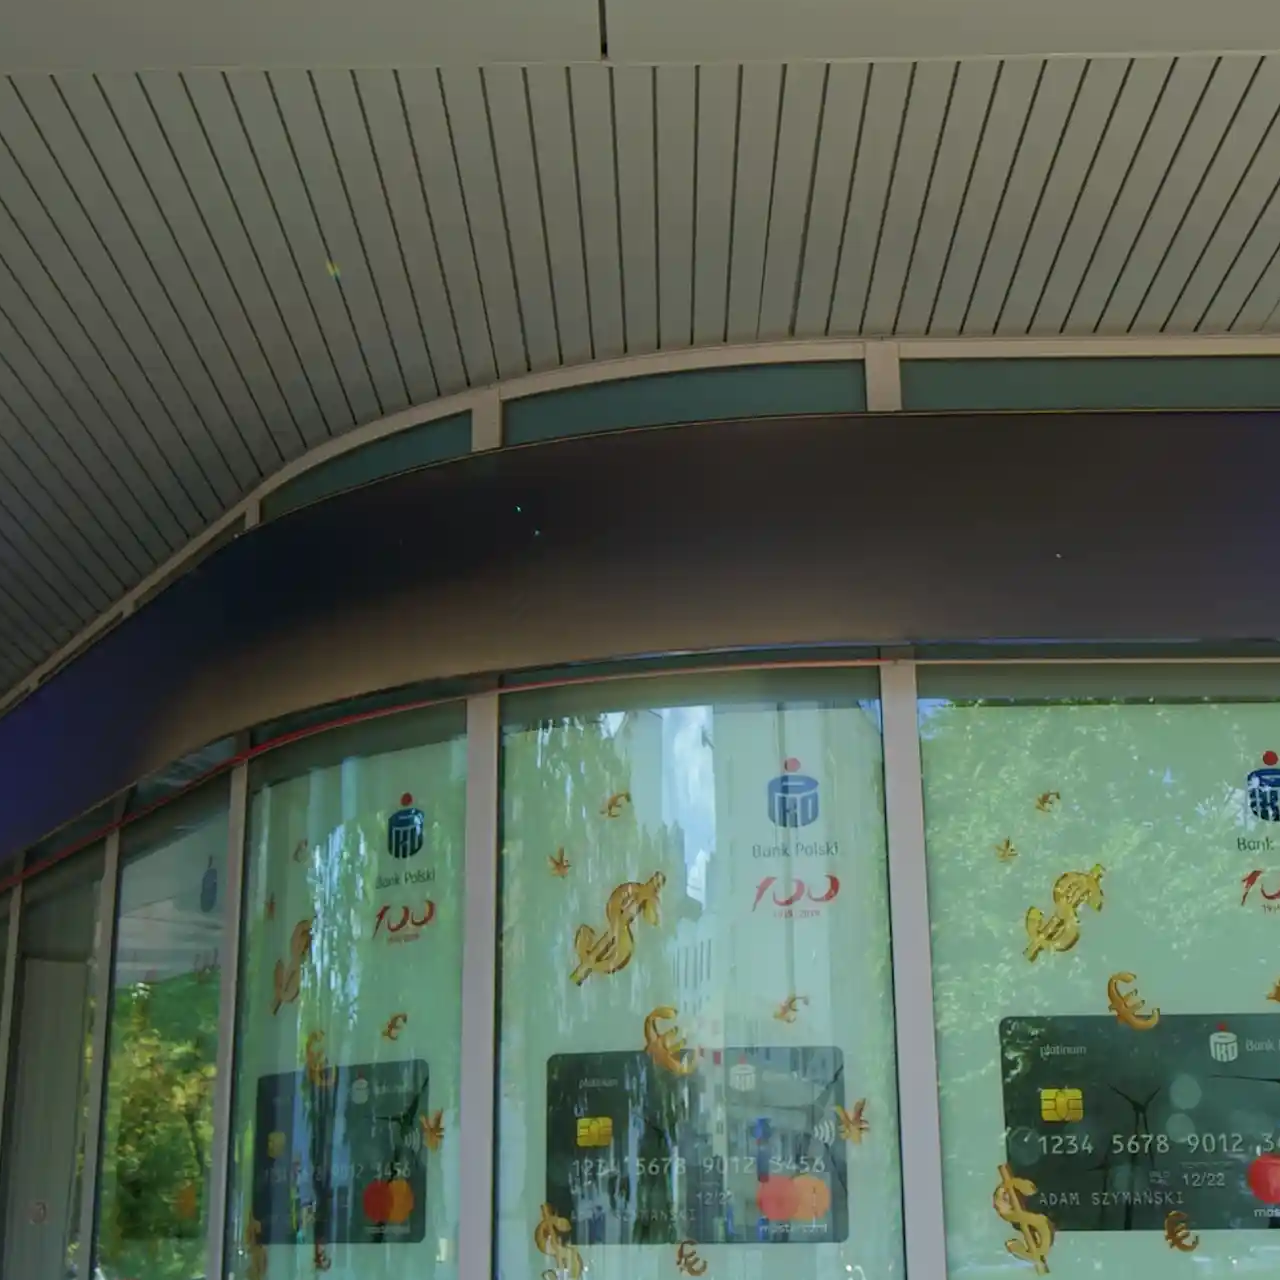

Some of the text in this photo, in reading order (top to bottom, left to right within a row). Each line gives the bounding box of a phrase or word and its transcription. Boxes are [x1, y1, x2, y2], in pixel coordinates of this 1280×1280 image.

[796, 841, 839, 858] Polski
[1237, 836, 1274, 851] Bank
[1037, 1135, 1094, 1155] 1234
[1111, 1134, 1170, 1154] 5678
[1188, 1132, 1244, 1154] 9012
[1182, 1171, 1227, 1188] 12/22
[1039, 1192, 1080, 1207] ADAM
